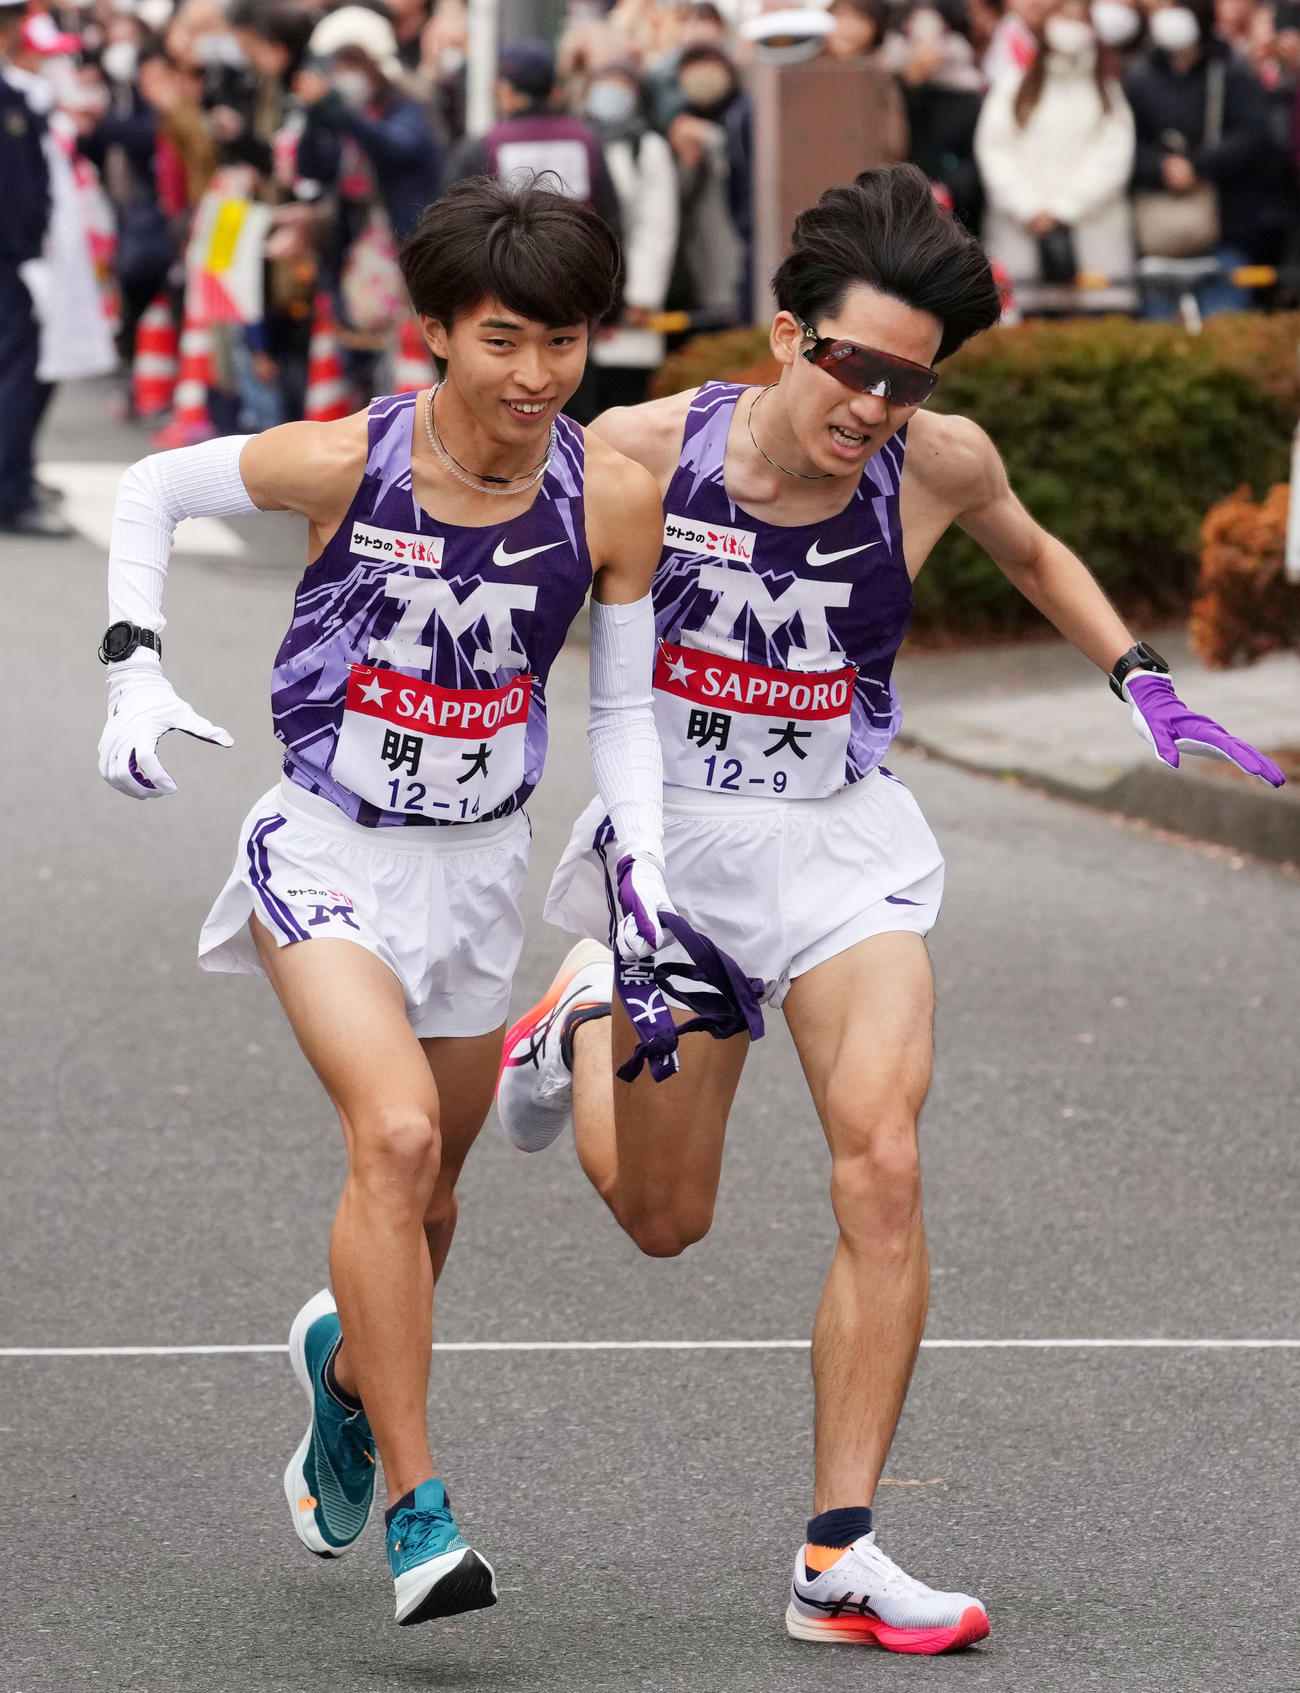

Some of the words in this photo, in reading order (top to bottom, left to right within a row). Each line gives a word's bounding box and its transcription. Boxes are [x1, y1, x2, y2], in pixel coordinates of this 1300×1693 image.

[353, 532, 440, 565] サトウのごはん
[665, 525, 751, 558] サトウのごはん
[367, 573, 539, 673] M
[680, 564, 854, 672] M
[701, 666, 848, 711] SAPPORO
[703, 754, 788, 793] 12-9
